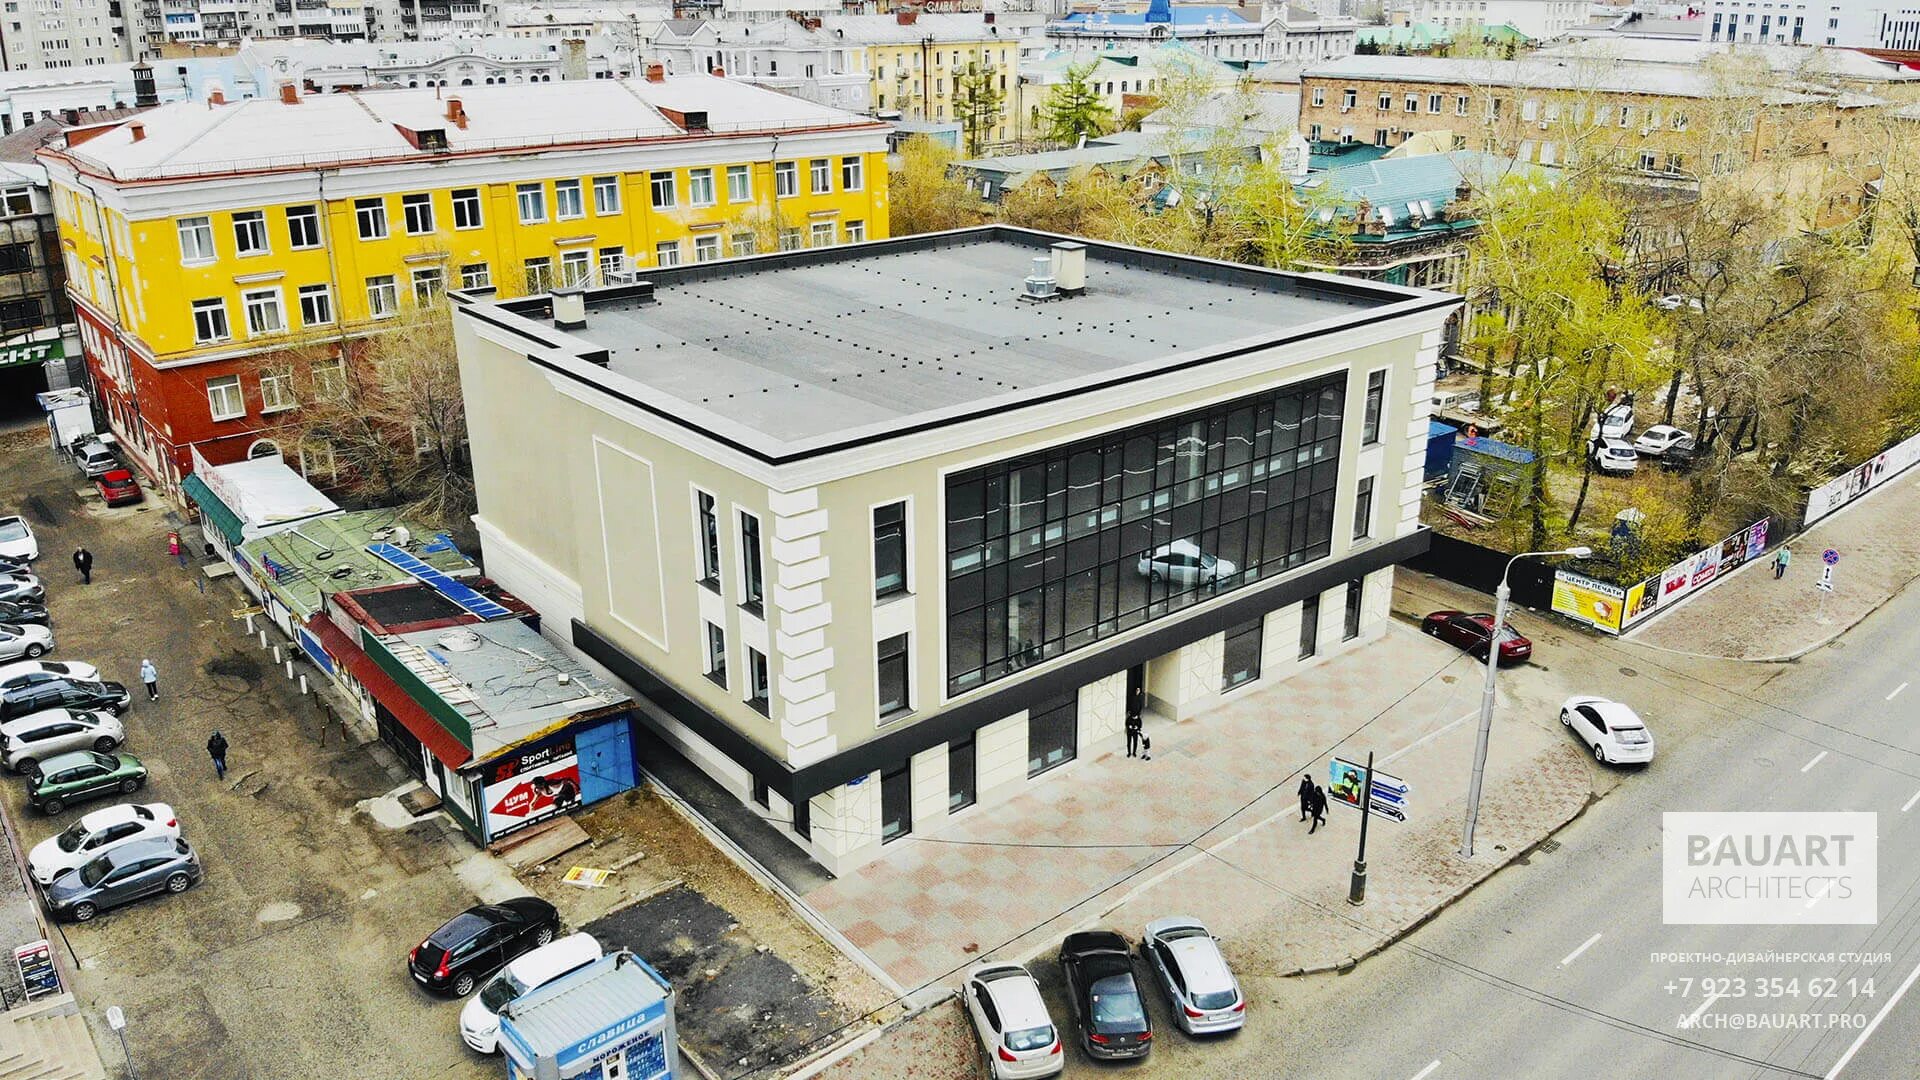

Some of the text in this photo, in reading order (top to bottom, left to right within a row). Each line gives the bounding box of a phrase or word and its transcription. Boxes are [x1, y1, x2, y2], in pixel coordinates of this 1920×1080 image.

[1566, 575, 1622, 596] ЦЕНТР ПЕЧАТИ
[504, 791, 529, 807] ЦУМ
[577, 1011, 647, 1054] славица
[592, 1030, 651, 1064] МОРОЖЕНОЕ
